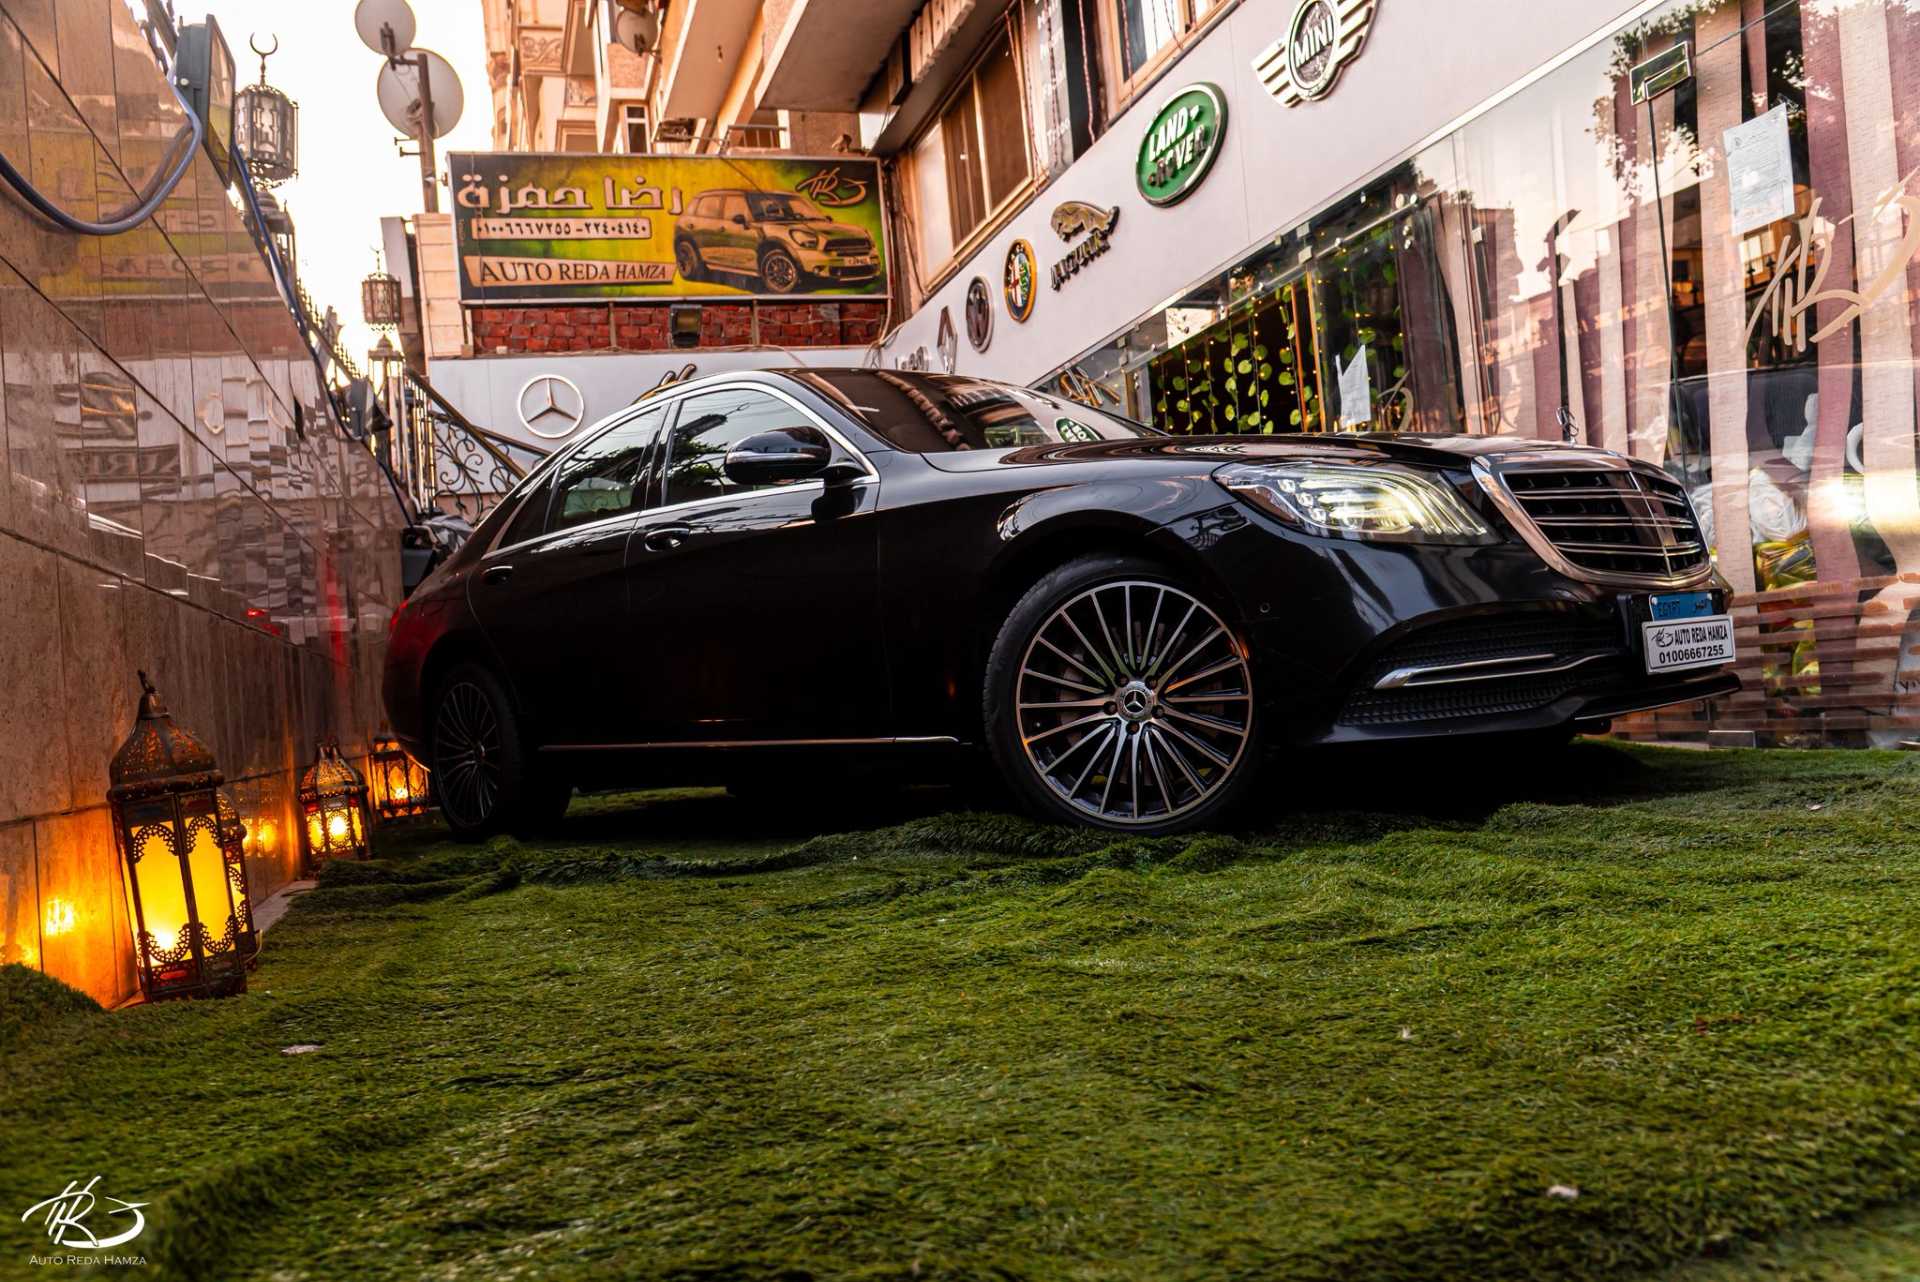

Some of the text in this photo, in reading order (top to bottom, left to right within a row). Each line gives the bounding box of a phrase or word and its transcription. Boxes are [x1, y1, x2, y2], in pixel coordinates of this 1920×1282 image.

[1294, 14, 1334, 68] MINI
[1149, 107, 1188, 162] LAND
[457, 174, 684, 215] رضا حمزة
[481, 262, 667, 282] AUTO REDA HAMZA
[1674, 628, 1691, 646] AUTO
[1691, 626, 1707, 643] REDA
[1707, 624, 1728, 642] HAMZA
[1659, 644, 1724, 664] 01006667255
